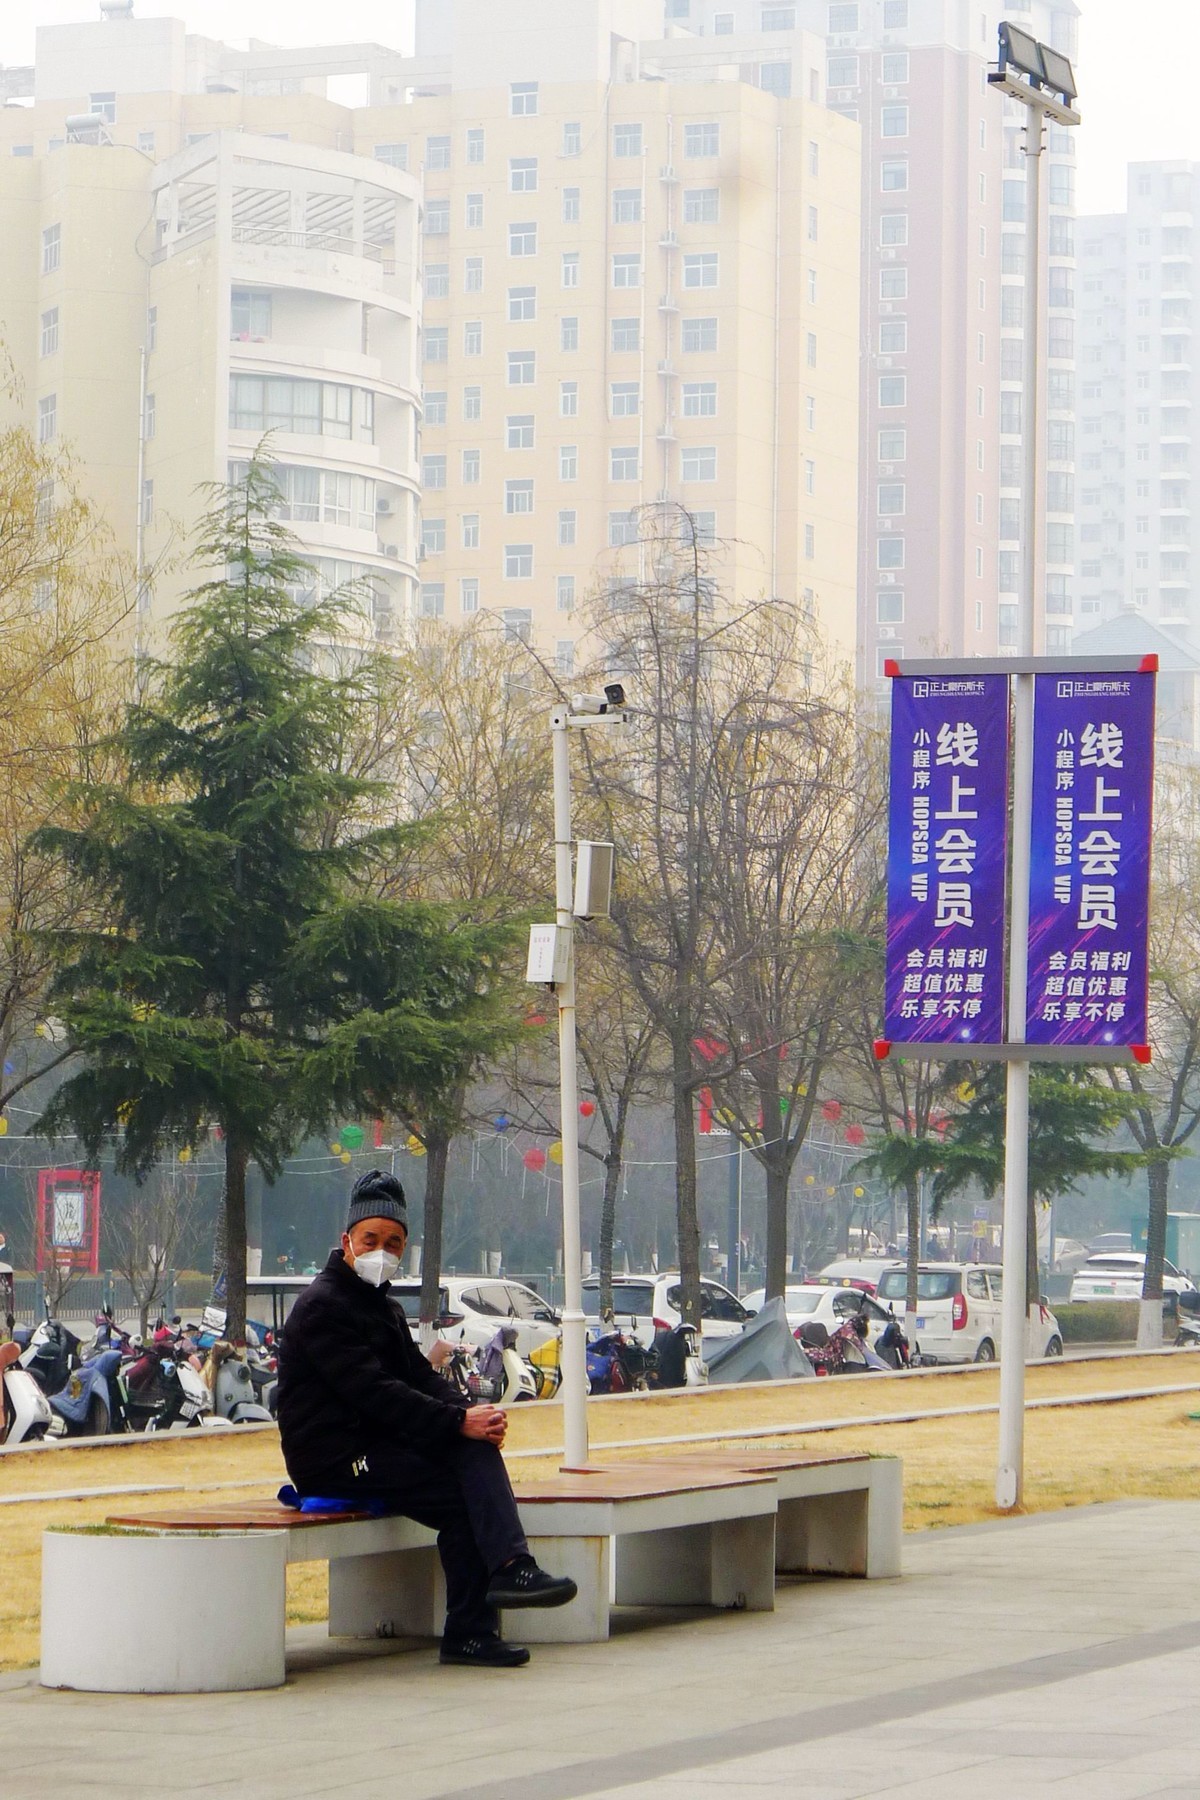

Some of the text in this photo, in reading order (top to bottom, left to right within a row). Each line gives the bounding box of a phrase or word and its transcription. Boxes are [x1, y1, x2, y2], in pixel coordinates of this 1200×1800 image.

[911, 728, 931, 902] 小程序 HOPSCA VIP
[934, 722, 979, 928] 线上会员
[1054, 728, 1075, 904] 小程序 HOPSCA VIP
[1077, 722, 1124, 930] 线上会员
[906, 948, 988, 969] 会员福利
[1049, 950, 1132, 971] 会员福利
[902, 973, 985, 993] 超值优惠
[1045, 976, 1129, 997] 超值优惠
[900, 998, 983, 1019] 乐享不停
[1041, 1001, 1126, 1022] 乐享不停
